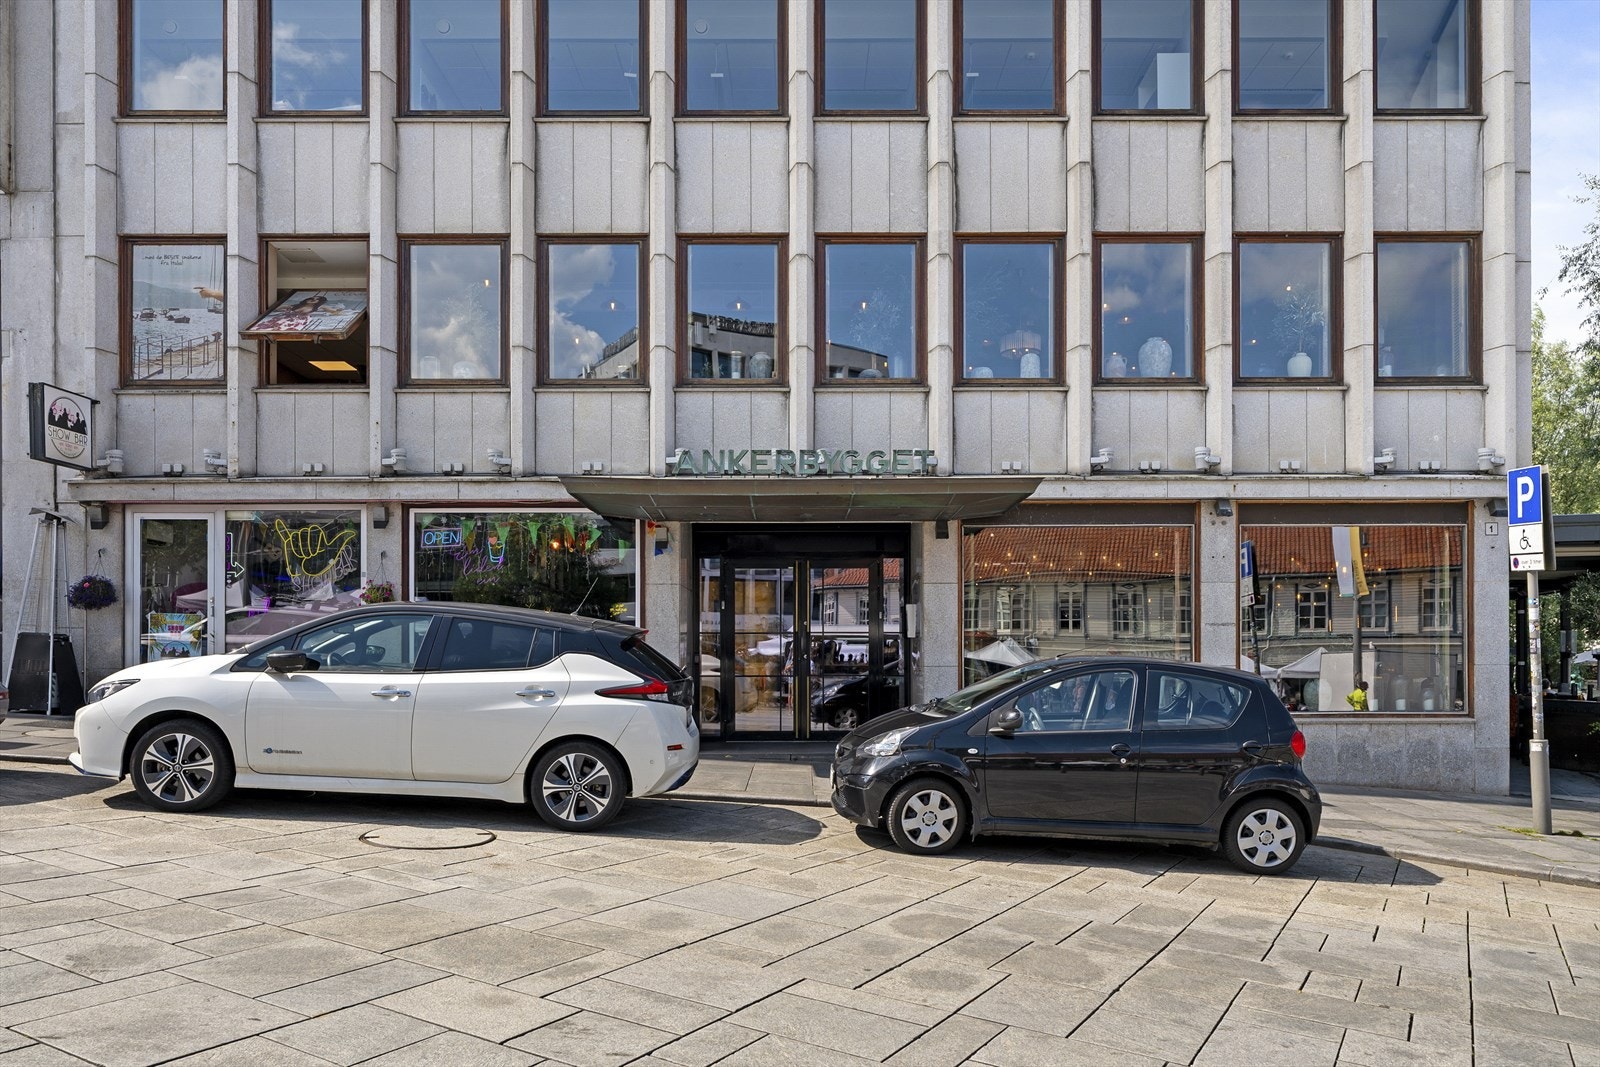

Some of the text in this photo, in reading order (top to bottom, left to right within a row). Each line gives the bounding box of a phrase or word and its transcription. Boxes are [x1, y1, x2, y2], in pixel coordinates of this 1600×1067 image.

[48, 426, 88, 446] SHOW BAR
[671, 449, 936, 475] ANKERBYGGET
[1517, 476, 1534, 518] P
[424, 532, 460, 545] OPEN
